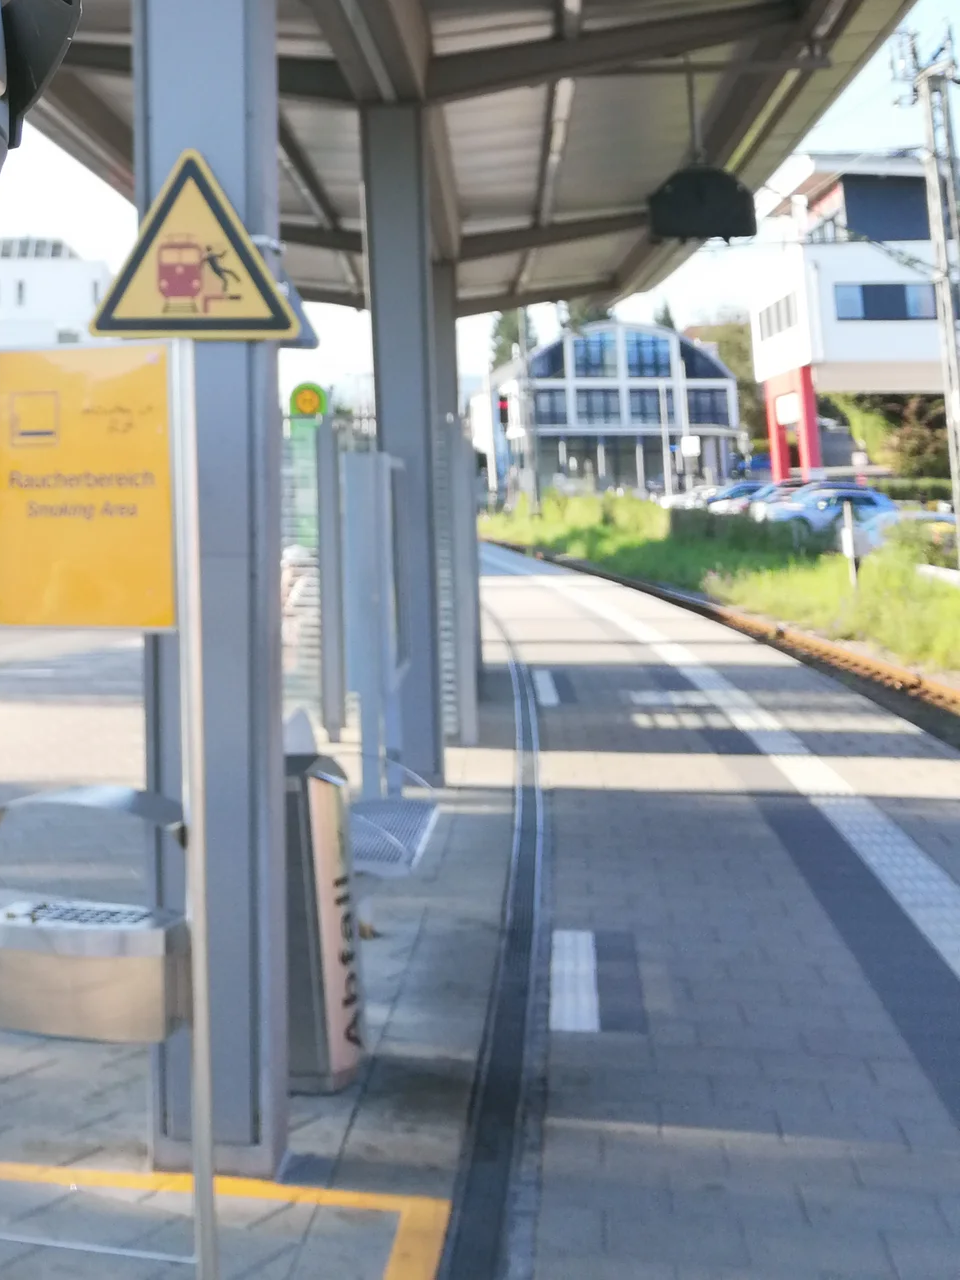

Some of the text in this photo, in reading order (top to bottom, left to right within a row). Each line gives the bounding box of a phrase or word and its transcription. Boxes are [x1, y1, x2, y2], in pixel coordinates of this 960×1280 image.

[8, 470, 156, 489] Raucherbereich
[26, 500, 138, 519] Smoking Area
